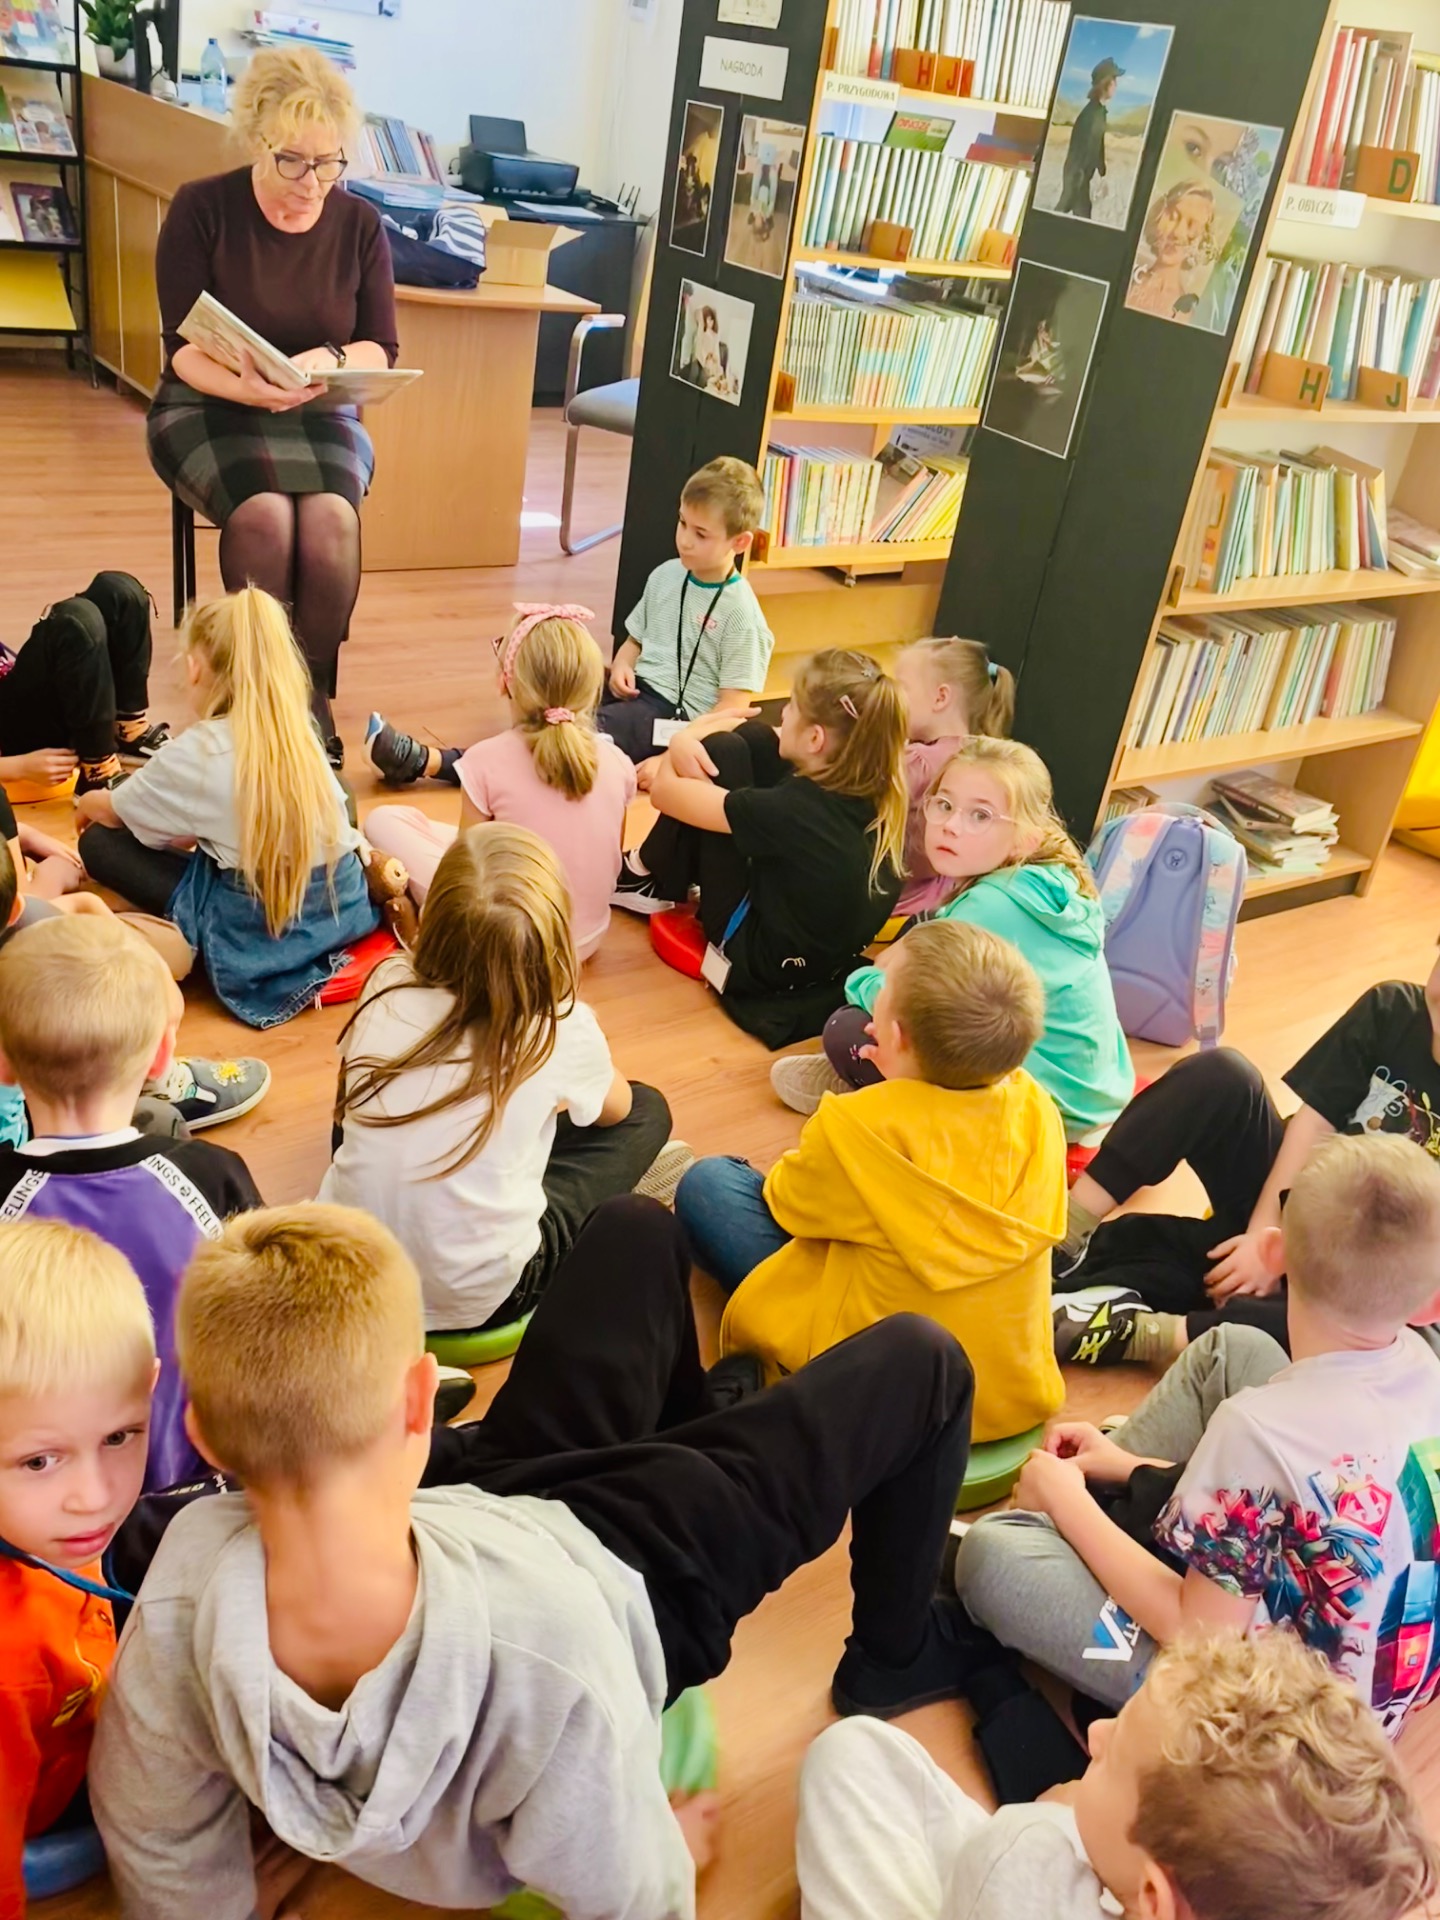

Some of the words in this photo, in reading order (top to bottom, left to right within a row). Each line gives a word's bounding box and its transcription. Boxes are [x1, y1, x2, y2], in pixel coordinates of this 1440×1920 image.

[720, 58, 763, 78] NAGRODA
[916, 55, 932, 85] H
[946, 62, 959, 90] J
[837, 83, 895, 101] PRZYGODOWA
[1387, 157, 1412, 194] D
[1299, 367, 1323, 404] H
[1386, 381, 1402, 408] J
[144, 1156, 181, 1187] INGS
